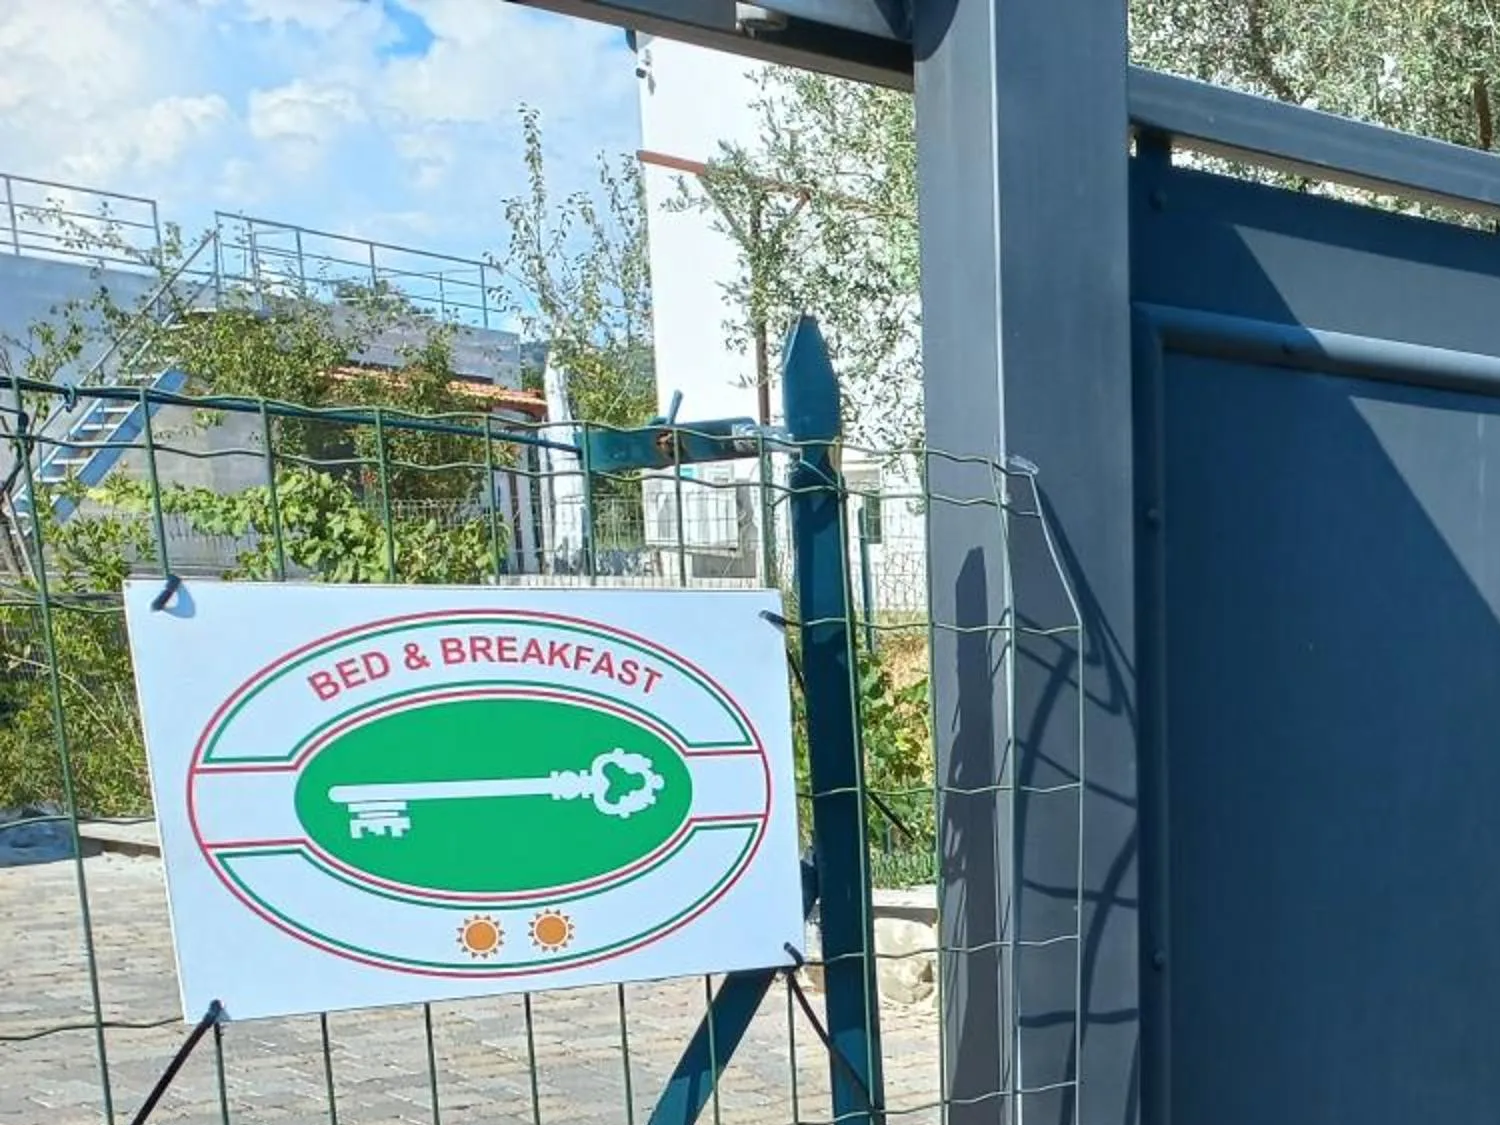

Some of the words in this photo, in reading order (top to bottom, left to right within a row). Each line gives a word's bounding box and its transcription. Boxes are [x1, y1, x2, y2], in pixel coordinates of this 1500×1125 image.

[307, 651, 391, 701] BED
[403, 643, 431, 671] &
[440, 636, 663, 694] BREAKFAST
